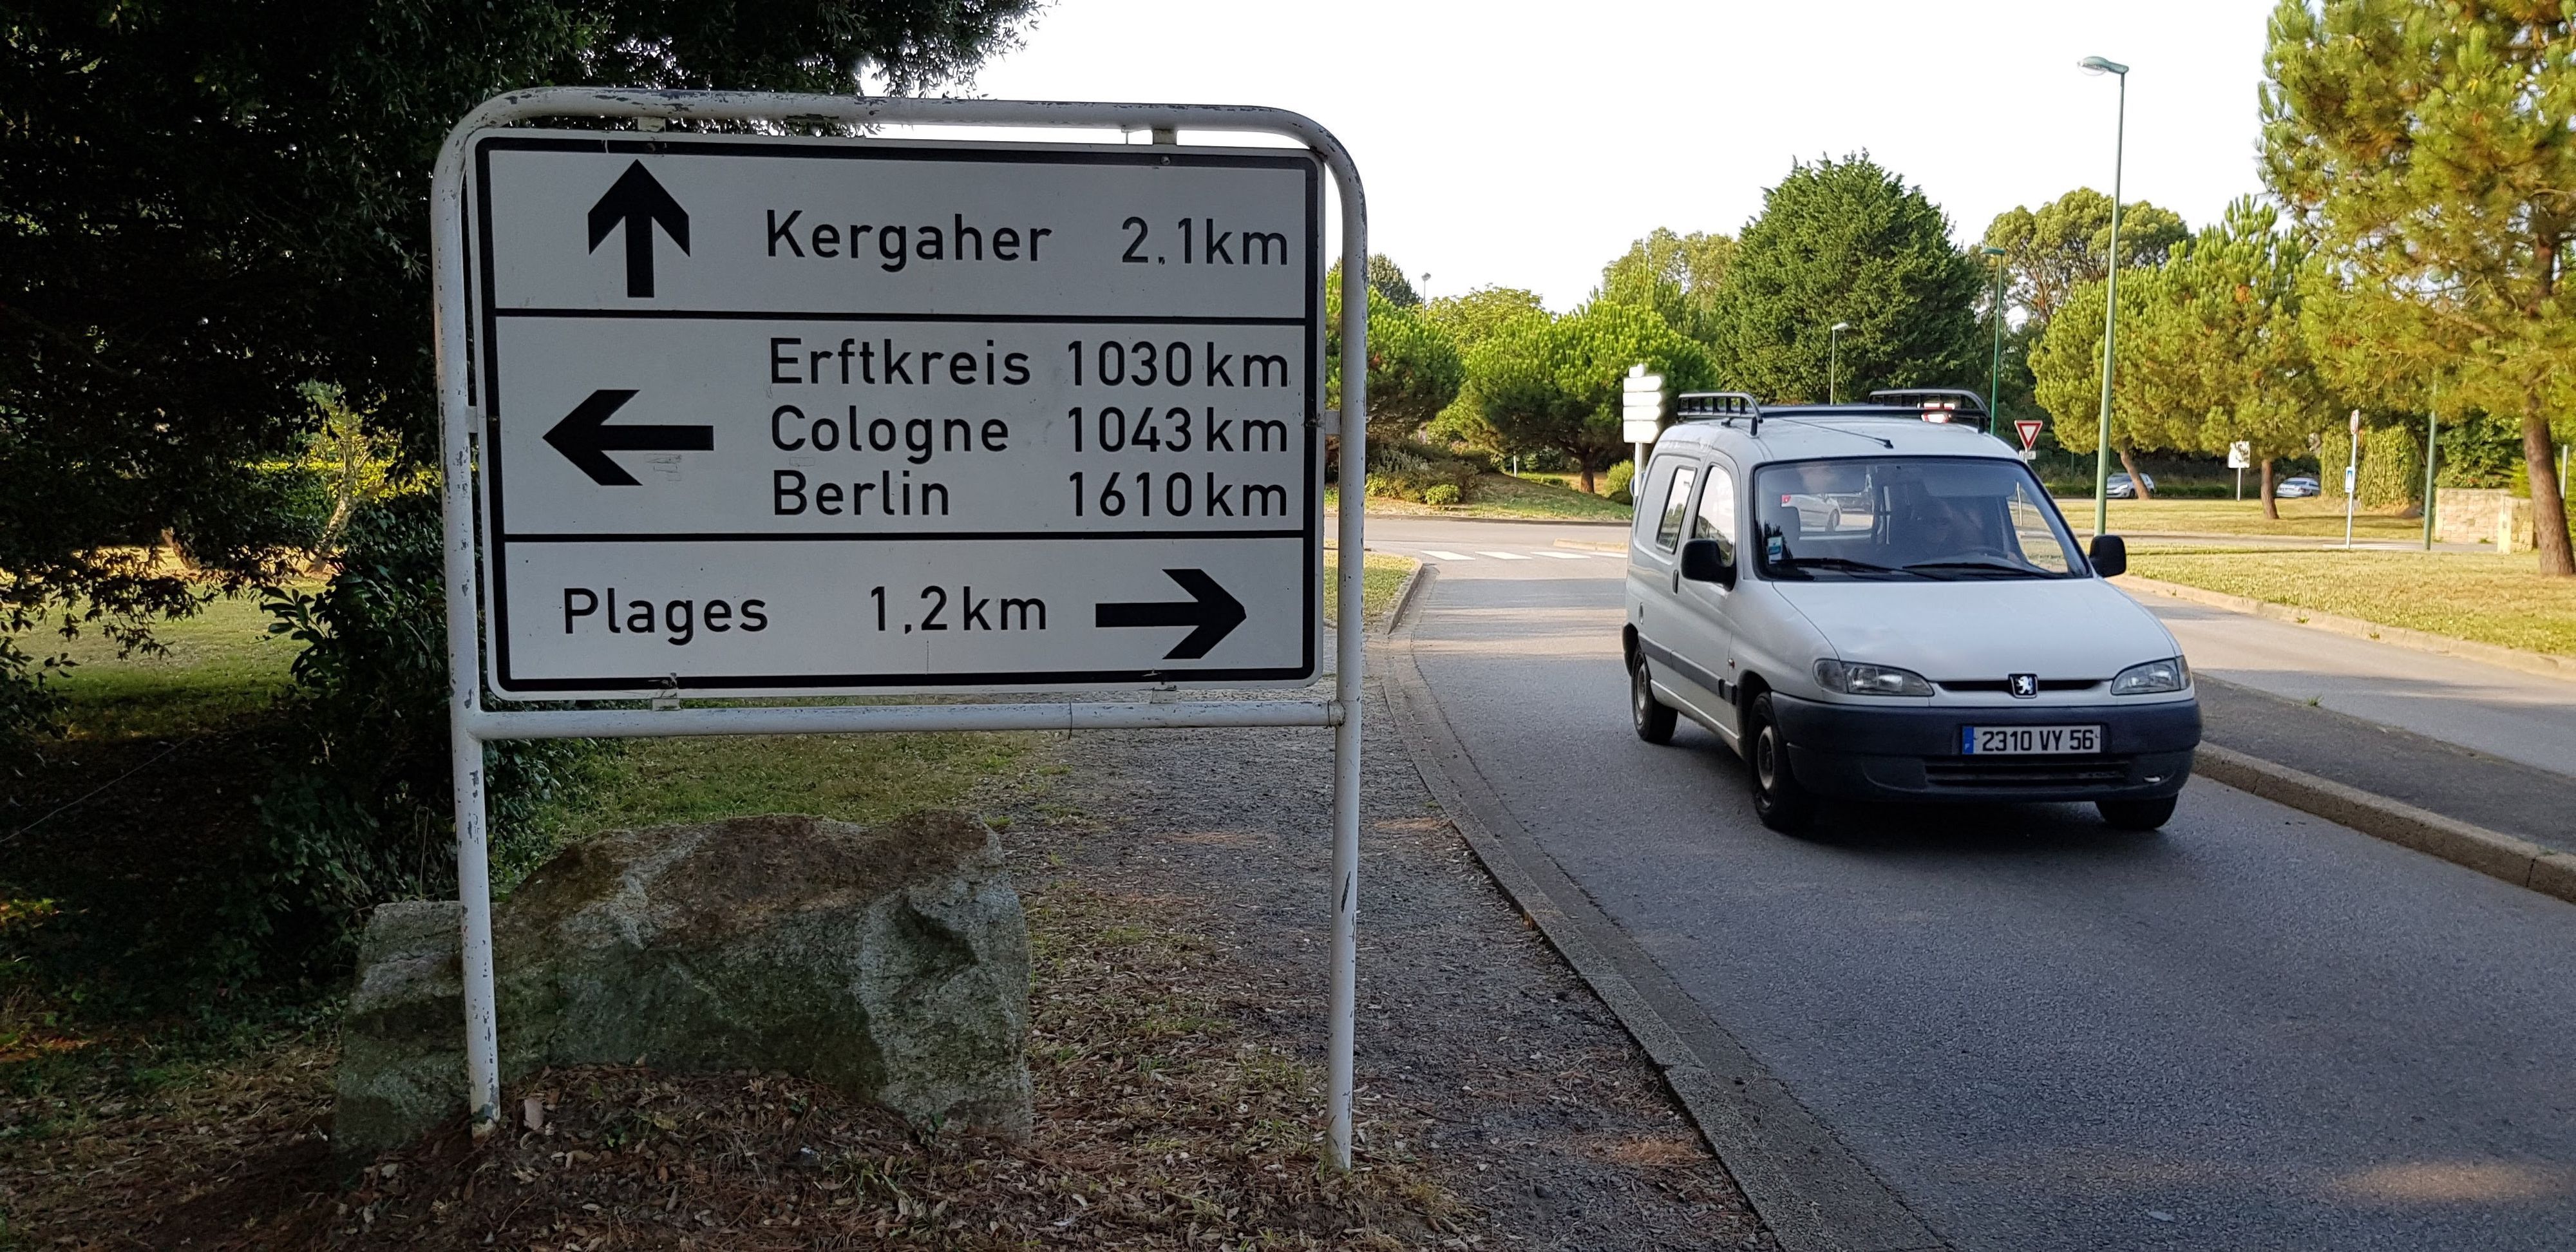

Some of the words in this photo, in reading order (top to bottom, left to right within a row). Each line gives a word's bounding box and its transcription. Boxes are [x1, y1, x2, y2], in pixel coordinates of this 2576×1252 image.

[767, 210, 1052, 273] Kergaher
[770, 337, 1030, 386] Erftkreis
[772, 404, 1009, 464] Cologne
[773, 470, 949, 516] Berlin
[564, 587, 768, 646] Plages
[1982, 730, 2032, 752] 2310
[2039, 730, 2063, 751] VY
[2069, 729, 2094, 750] 56
